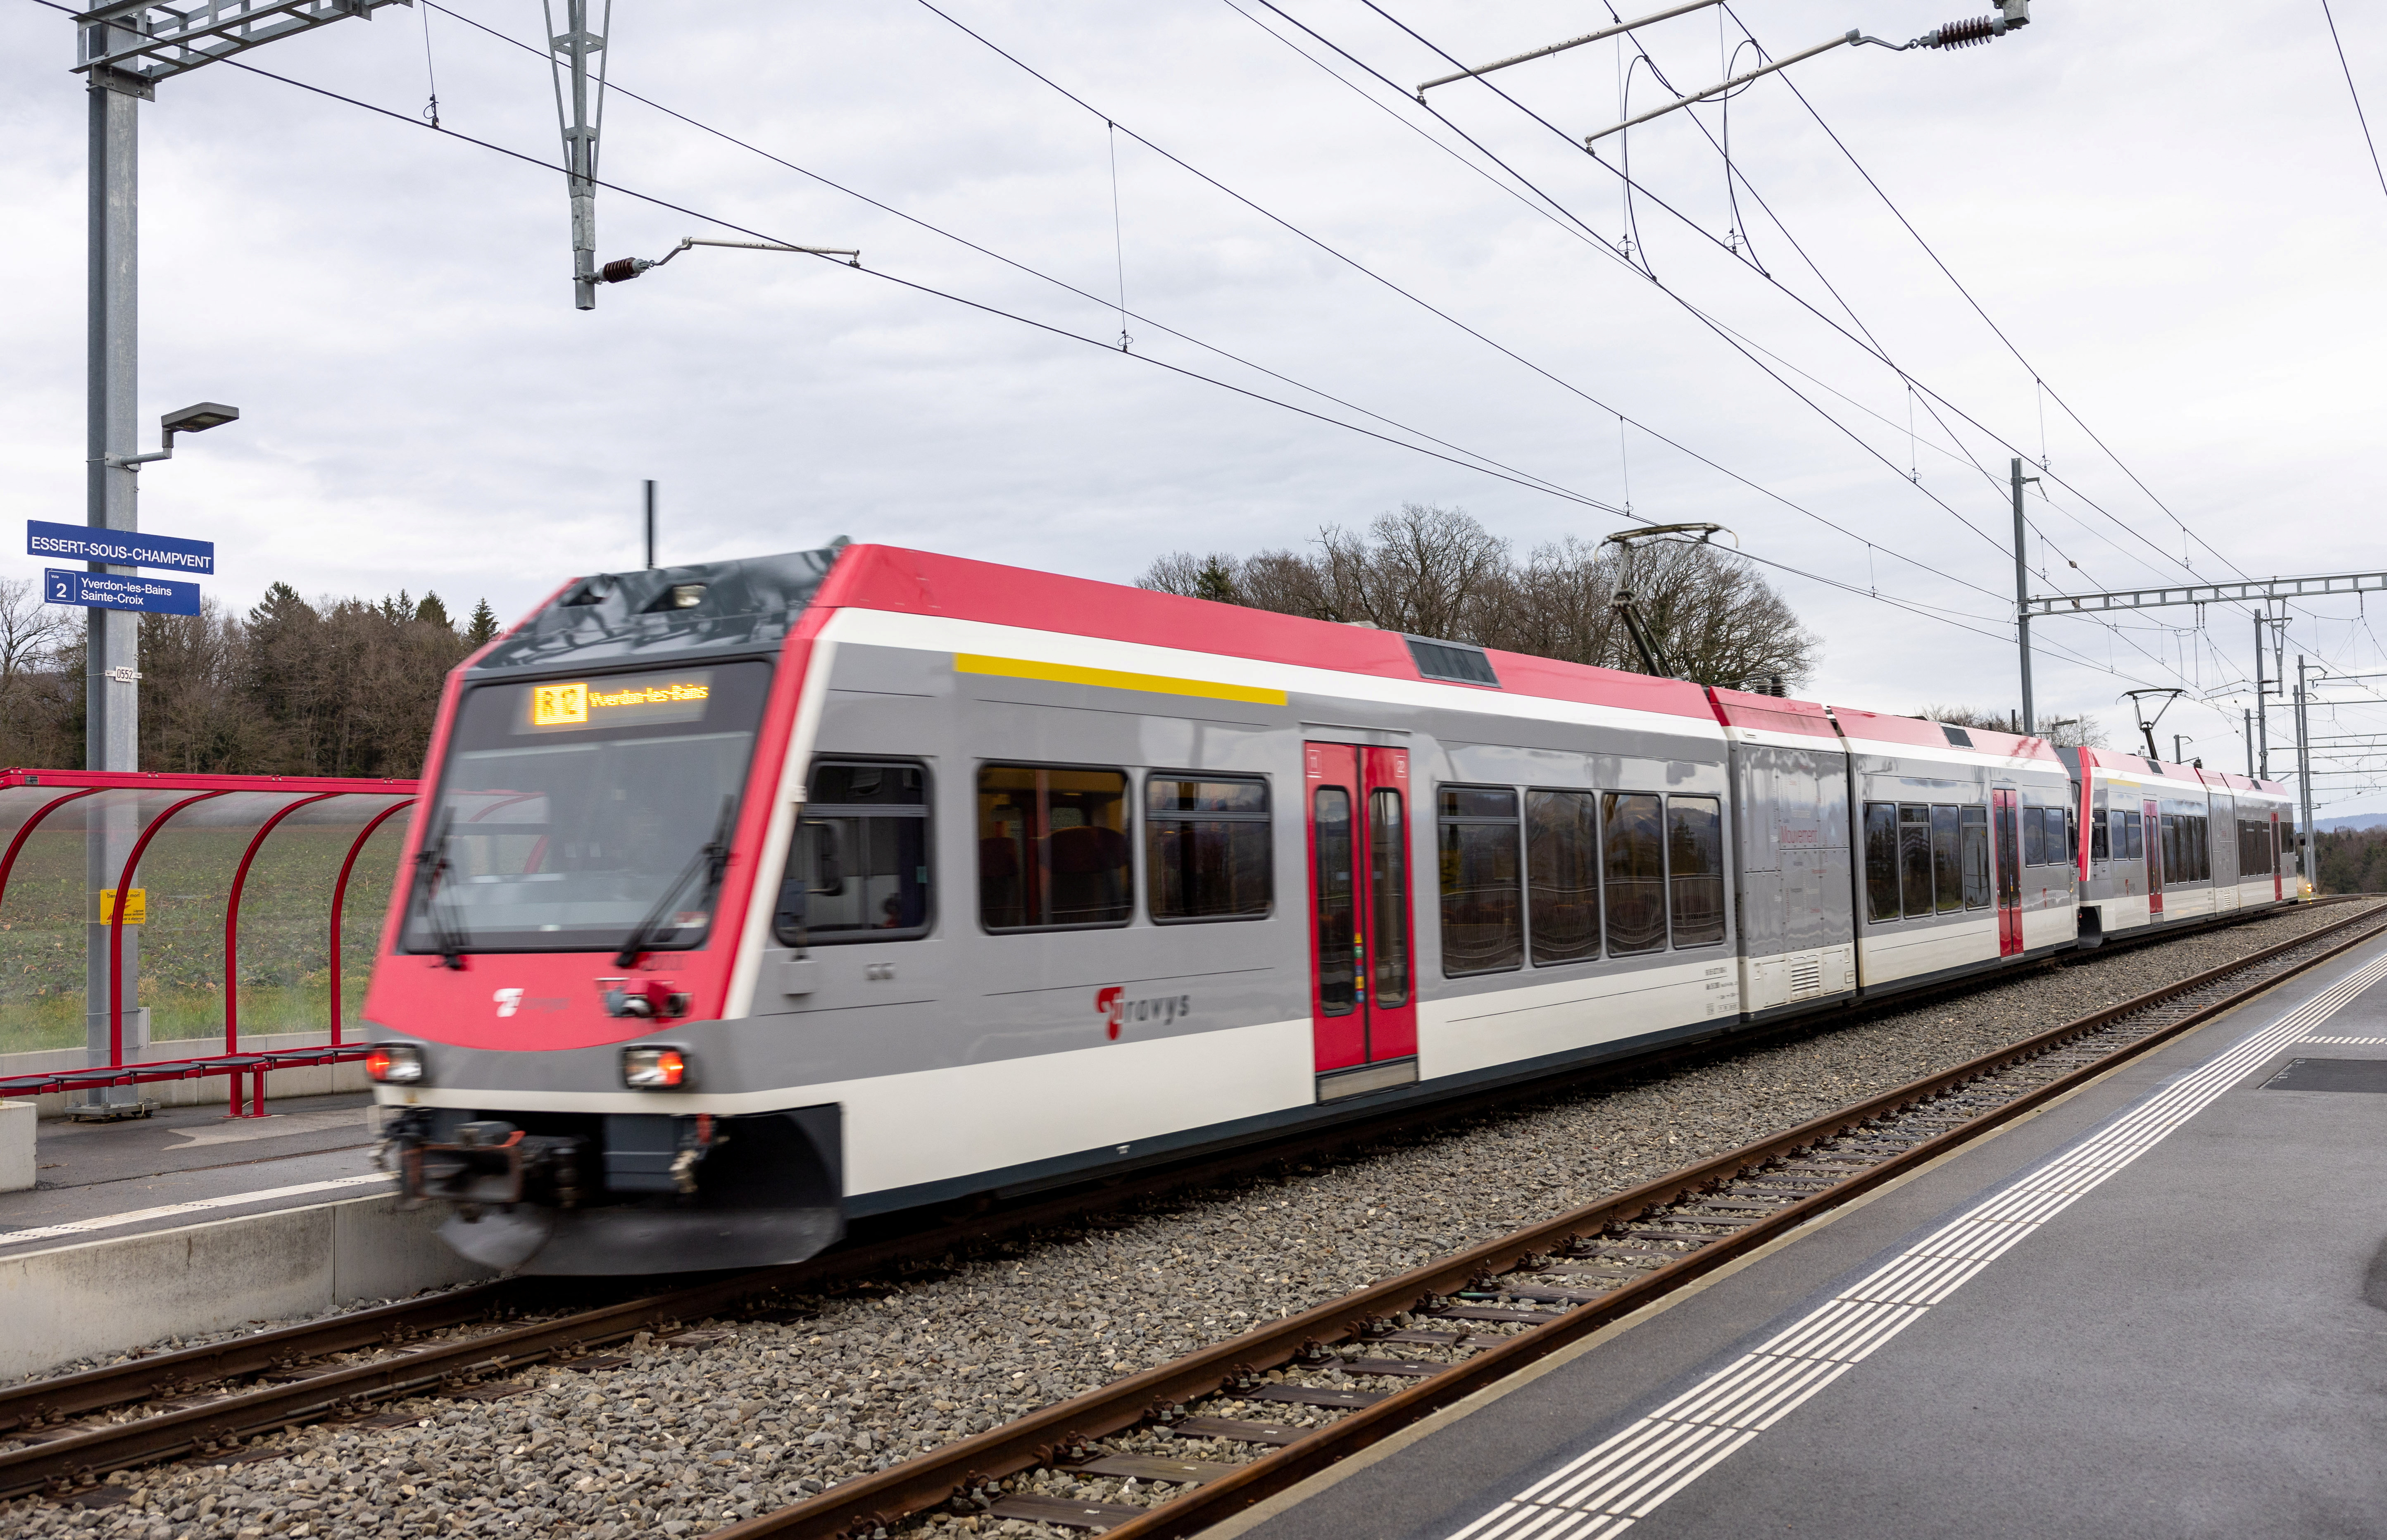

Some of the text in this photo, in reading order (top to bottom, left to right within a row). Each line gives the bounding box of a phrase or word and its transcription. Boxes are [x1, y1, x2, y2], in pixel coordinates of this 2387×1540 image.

[31, 536, 211, 568] ESSERT-SOUS-CHAMPVENT
[56, 583, 67, 597] 2
[81, 577, 172, 596] Yverdon-les-Bains
[81, 590, 144, 605] Sainte-Croix
[117, 669, 133, 679] 0552
